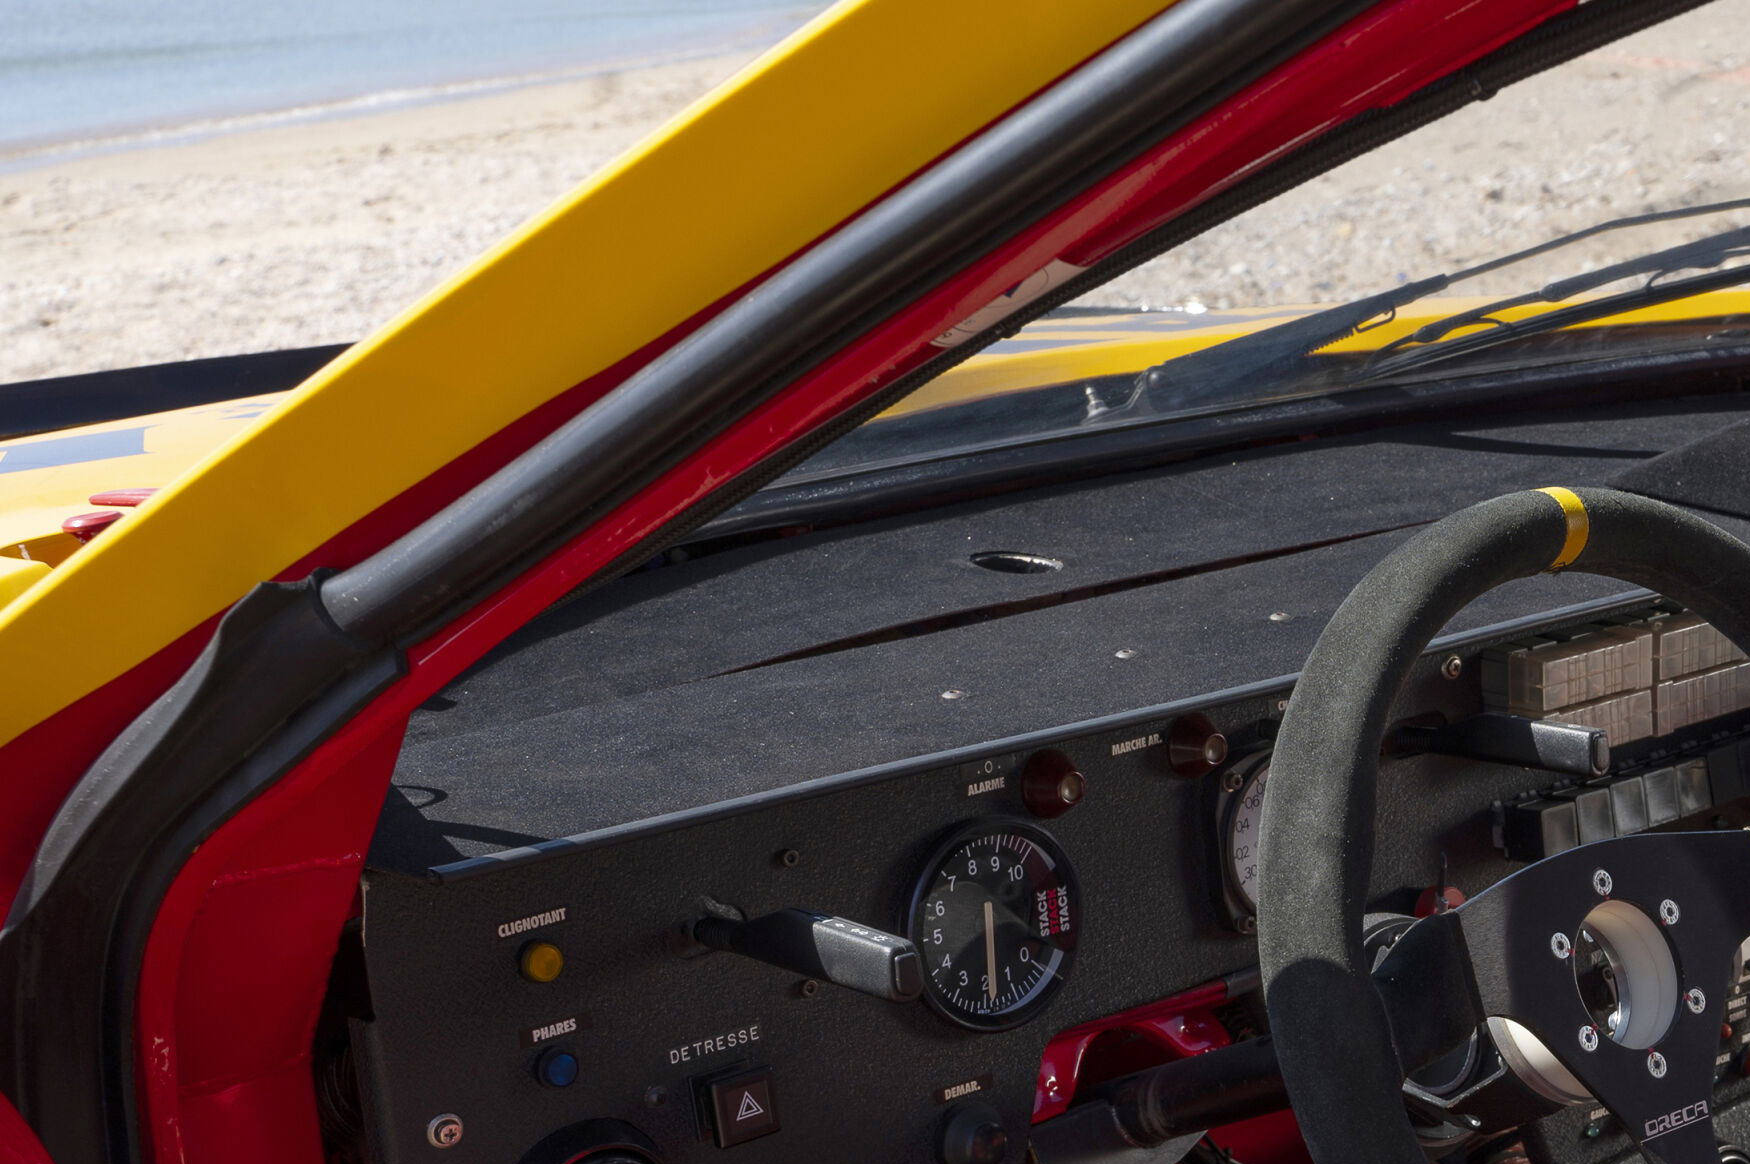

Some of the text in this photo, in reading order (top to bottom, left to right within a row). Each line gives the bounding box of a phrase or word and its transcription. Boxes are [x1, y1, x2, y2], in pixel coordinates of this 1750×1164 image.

[1111, 733, 1163, 757] MARCHE AR.
[967, 776, 1006, 797] ALARME
[967, 859, 977, 876] 8
[990, 856, 1000, 872] 9
[1007, 864, 1024, 882] 10
[947, 875, 957, 892] 7
[935, 900, 945, 917] 6
[1036, 890, 1050, 937] STACK
[1046, 888, 1060, 935] STACK
[1056, 885, 1070, 932] STACK
[498, 907, 567, 938] CLIGNOTANT
[933, 928, 943, 945] 5
[941, 953, 952, 969] 4
[1019, 947, 1029, 962] 0
[959, 970, 969, 986] 3
[981, 975, 990, 990] 2
[1004, 966, 1012, 981] 1
[532, 1018, 577, 1042] PHARES
[669, 1026, 760, 1065] DETRESSE
[944, 1080, 981, 1101] DEMAR.
[1644, 1100, 1709, 1137] ORECA
